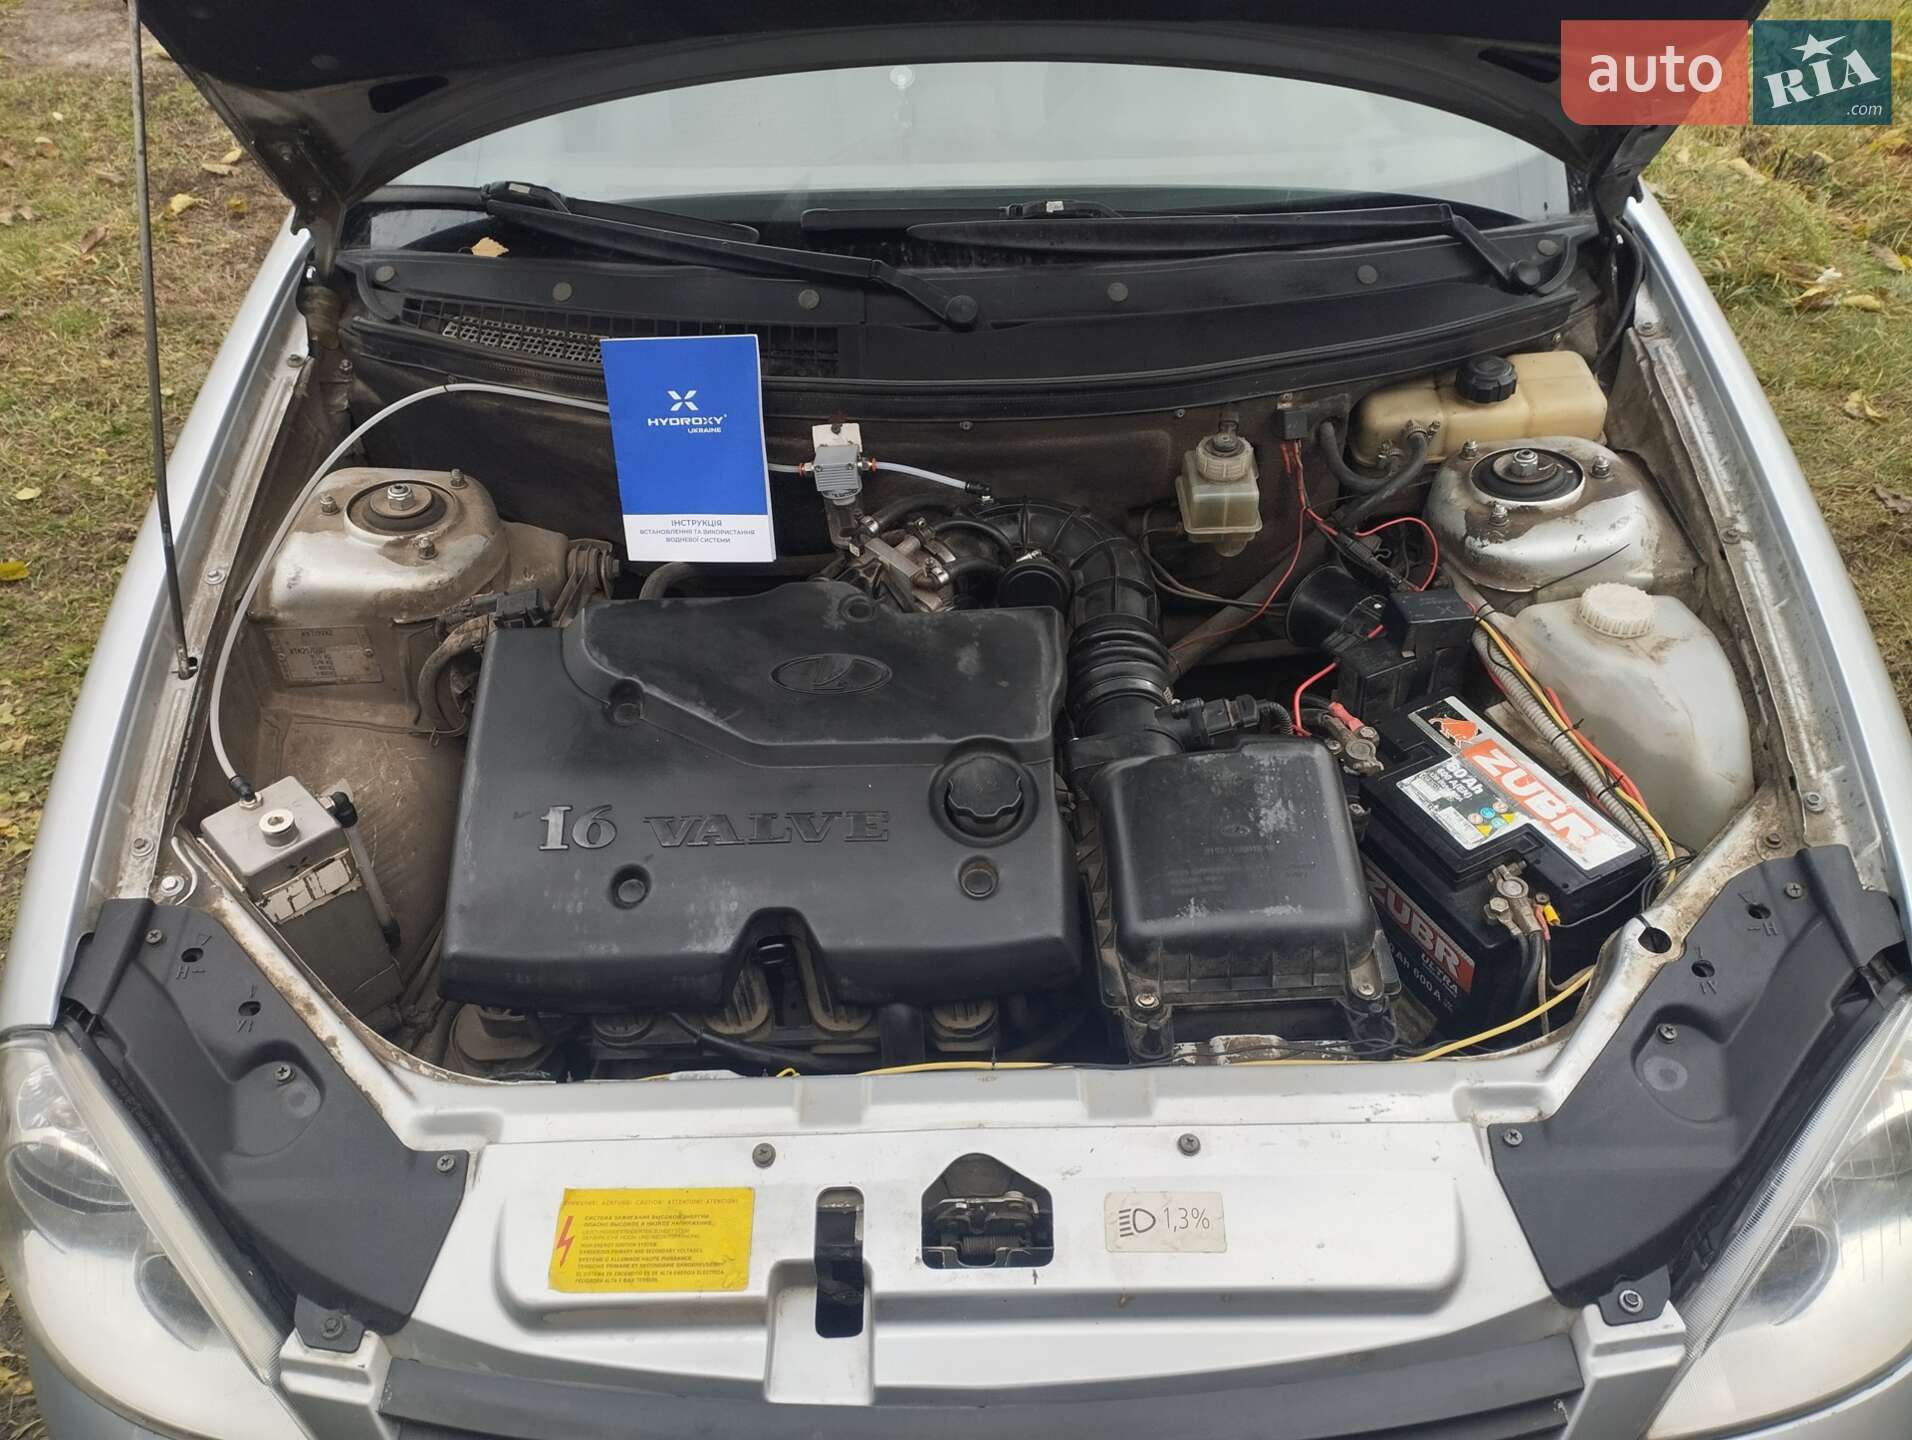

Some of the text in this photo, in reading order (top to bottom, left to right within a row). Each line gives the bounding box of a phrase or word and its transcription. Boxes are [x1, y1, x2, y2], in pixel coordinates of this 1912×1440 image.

[671, 519, 722, 527] ІНСТРУКЦІЯ
[1460, 777, 1484, 795] Ah
[1472, 747, 1596, 852] ZUBR
[538, 804, 891, 850] 16 VALVE
[1163, 1207, 1210, 1233] 1,3%
